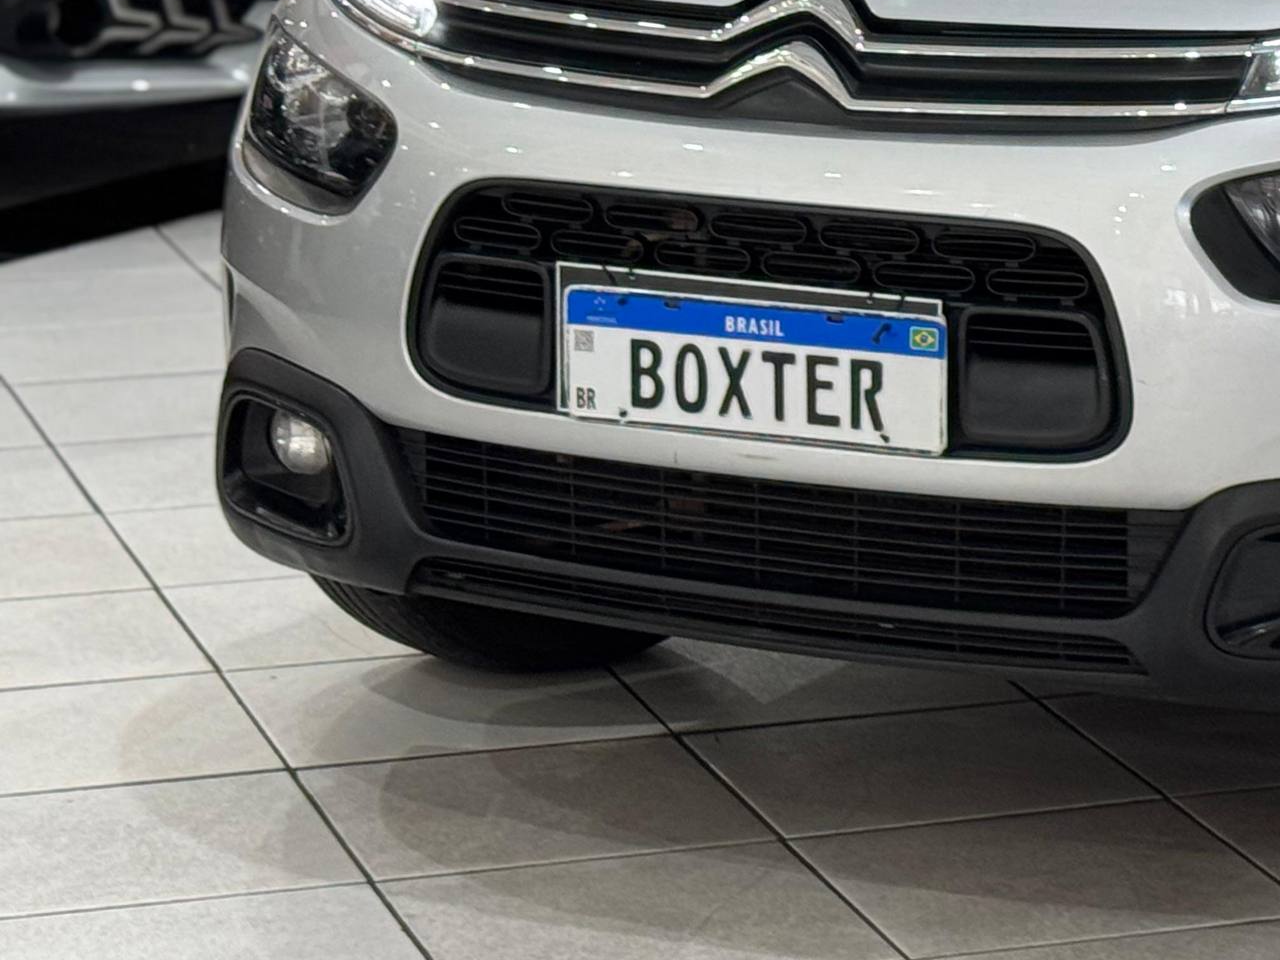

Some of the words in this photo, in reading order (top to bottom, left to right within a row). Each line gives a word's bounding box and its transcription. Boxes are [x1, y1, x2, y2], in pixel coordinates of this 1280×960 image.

[725, 315, 785, 338] BRASIL
[630, 338, 886, 432] BOXTER
[576, 386, 596, 411] BR
